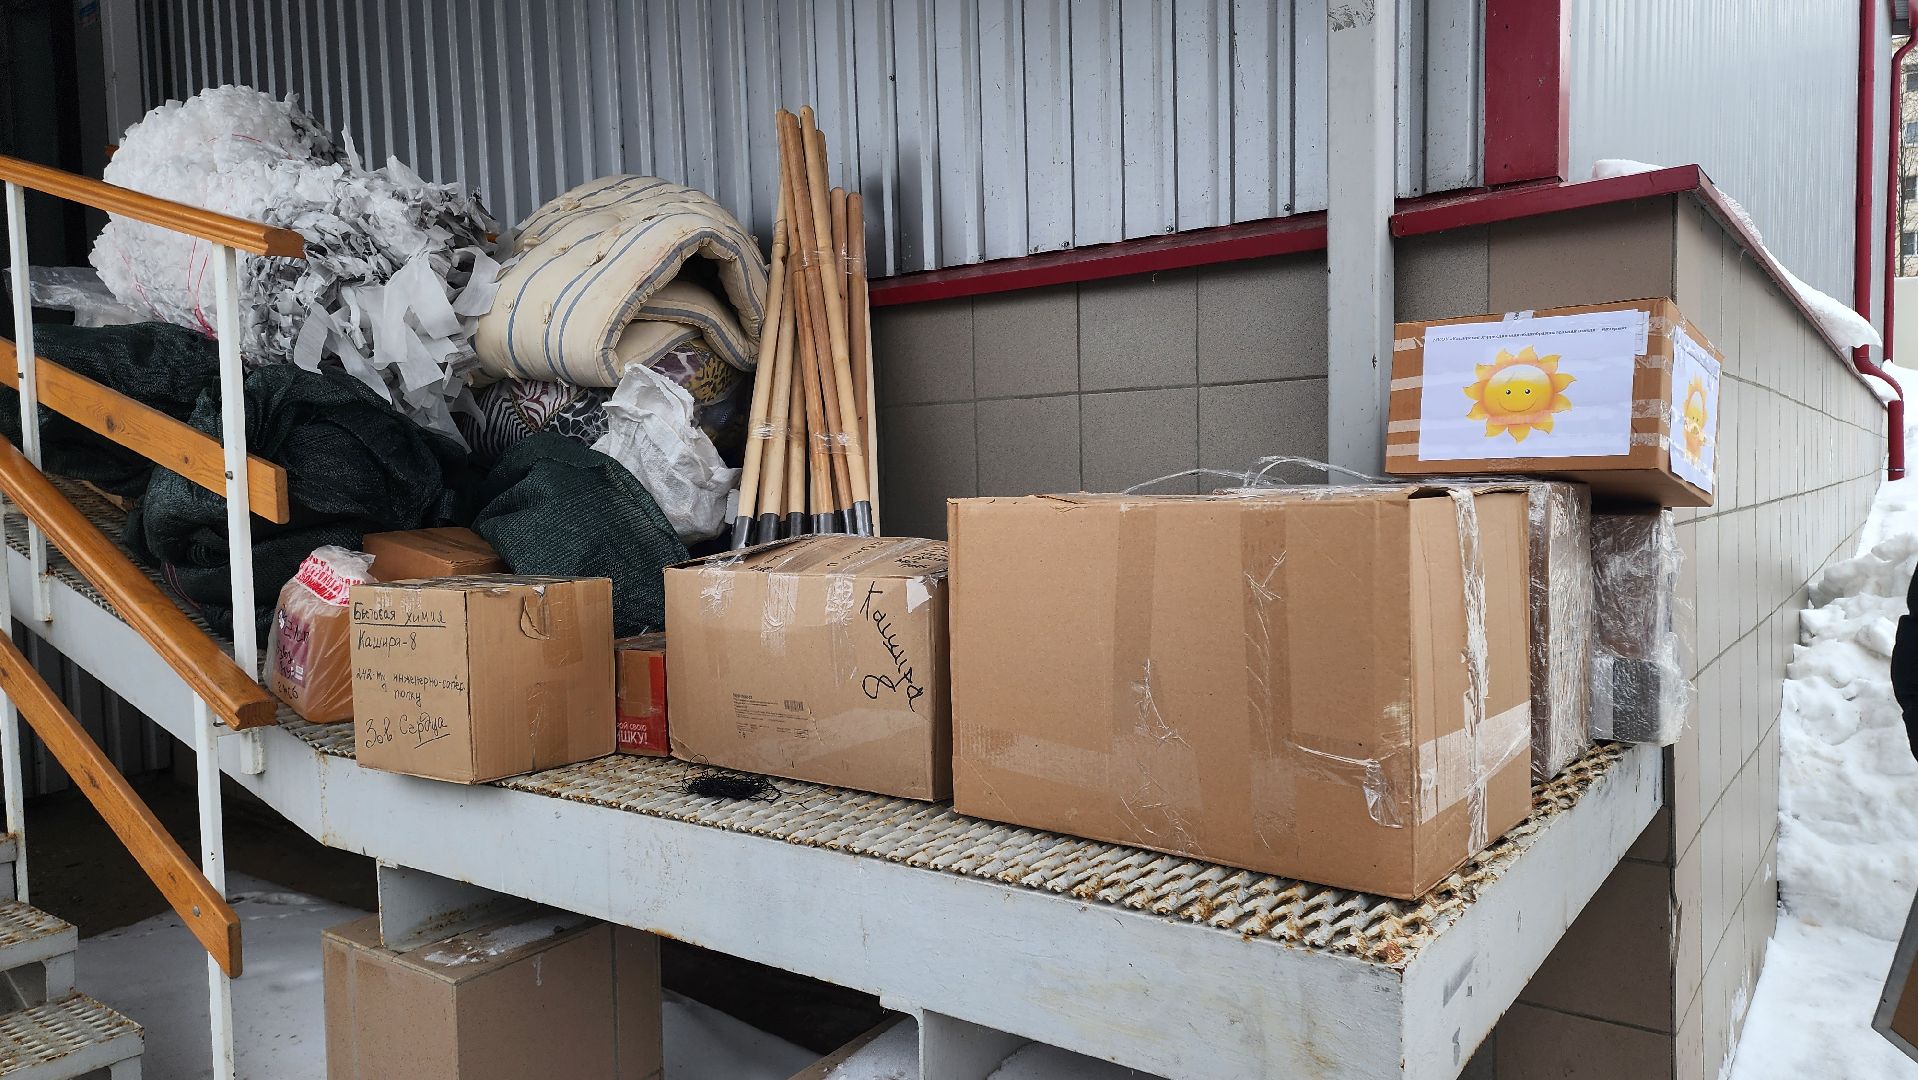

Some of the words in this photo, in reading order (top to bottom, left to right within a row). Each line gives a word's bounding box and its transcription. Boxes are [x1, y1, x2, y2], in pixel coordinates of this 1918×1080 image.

[353, 601, 396, 621] Бытовая
[405, 610, 447, 626] химия
[859, 581, 924, 712] Кашира
[394, 688, 421, 708] полку
[365, 716, 393, 748] Зов
[399, 712, 448, 742] Сердца
